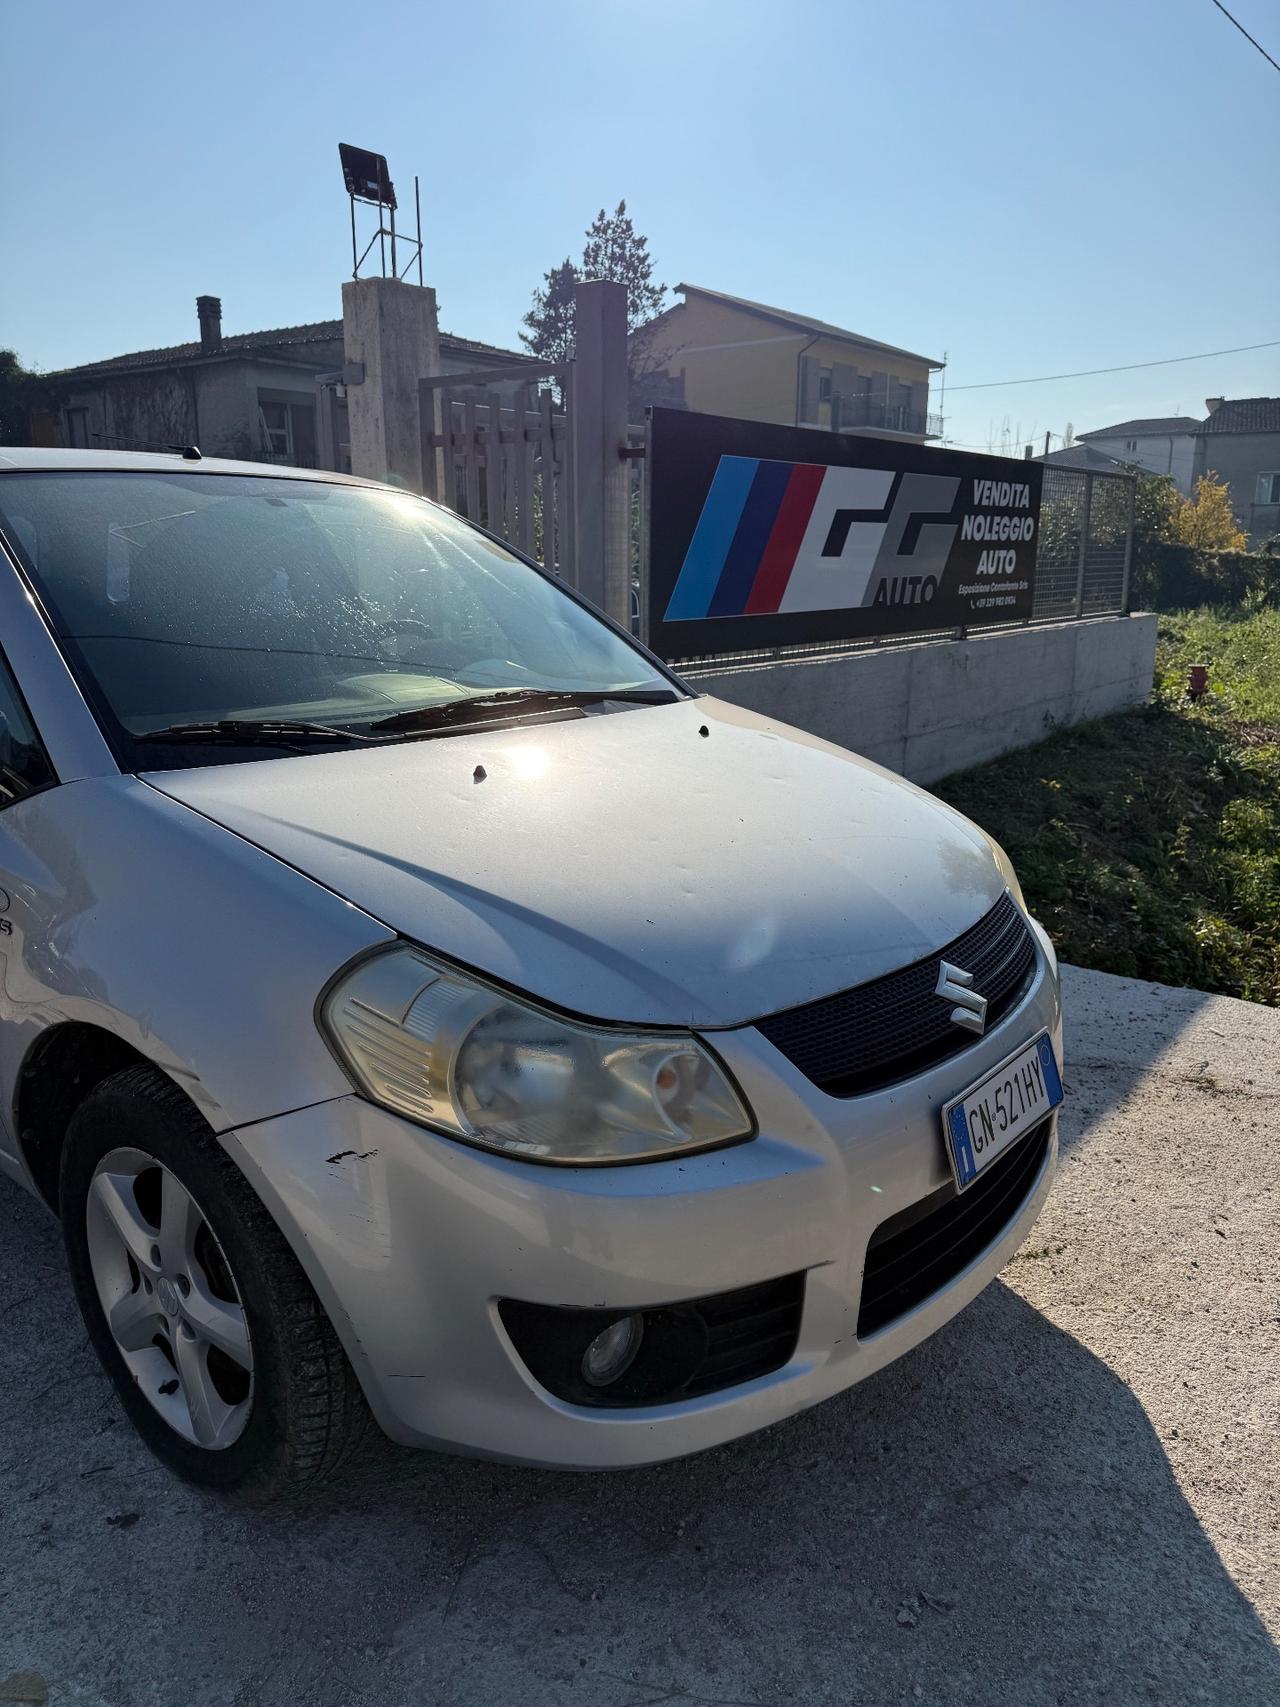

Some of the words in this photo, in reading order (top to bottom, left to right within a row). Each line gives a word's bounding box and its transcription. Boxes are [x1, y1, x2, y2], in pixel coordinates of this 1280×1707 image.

[973, 479, 1030, 508] VENDITA
[960, 514, 1034, 541] NOLEGGIO
[976, 549, 1017, 575] AUTO
[873, 574, 938, 607] AUTO
[958, 583, 990, 596] Esposizione
